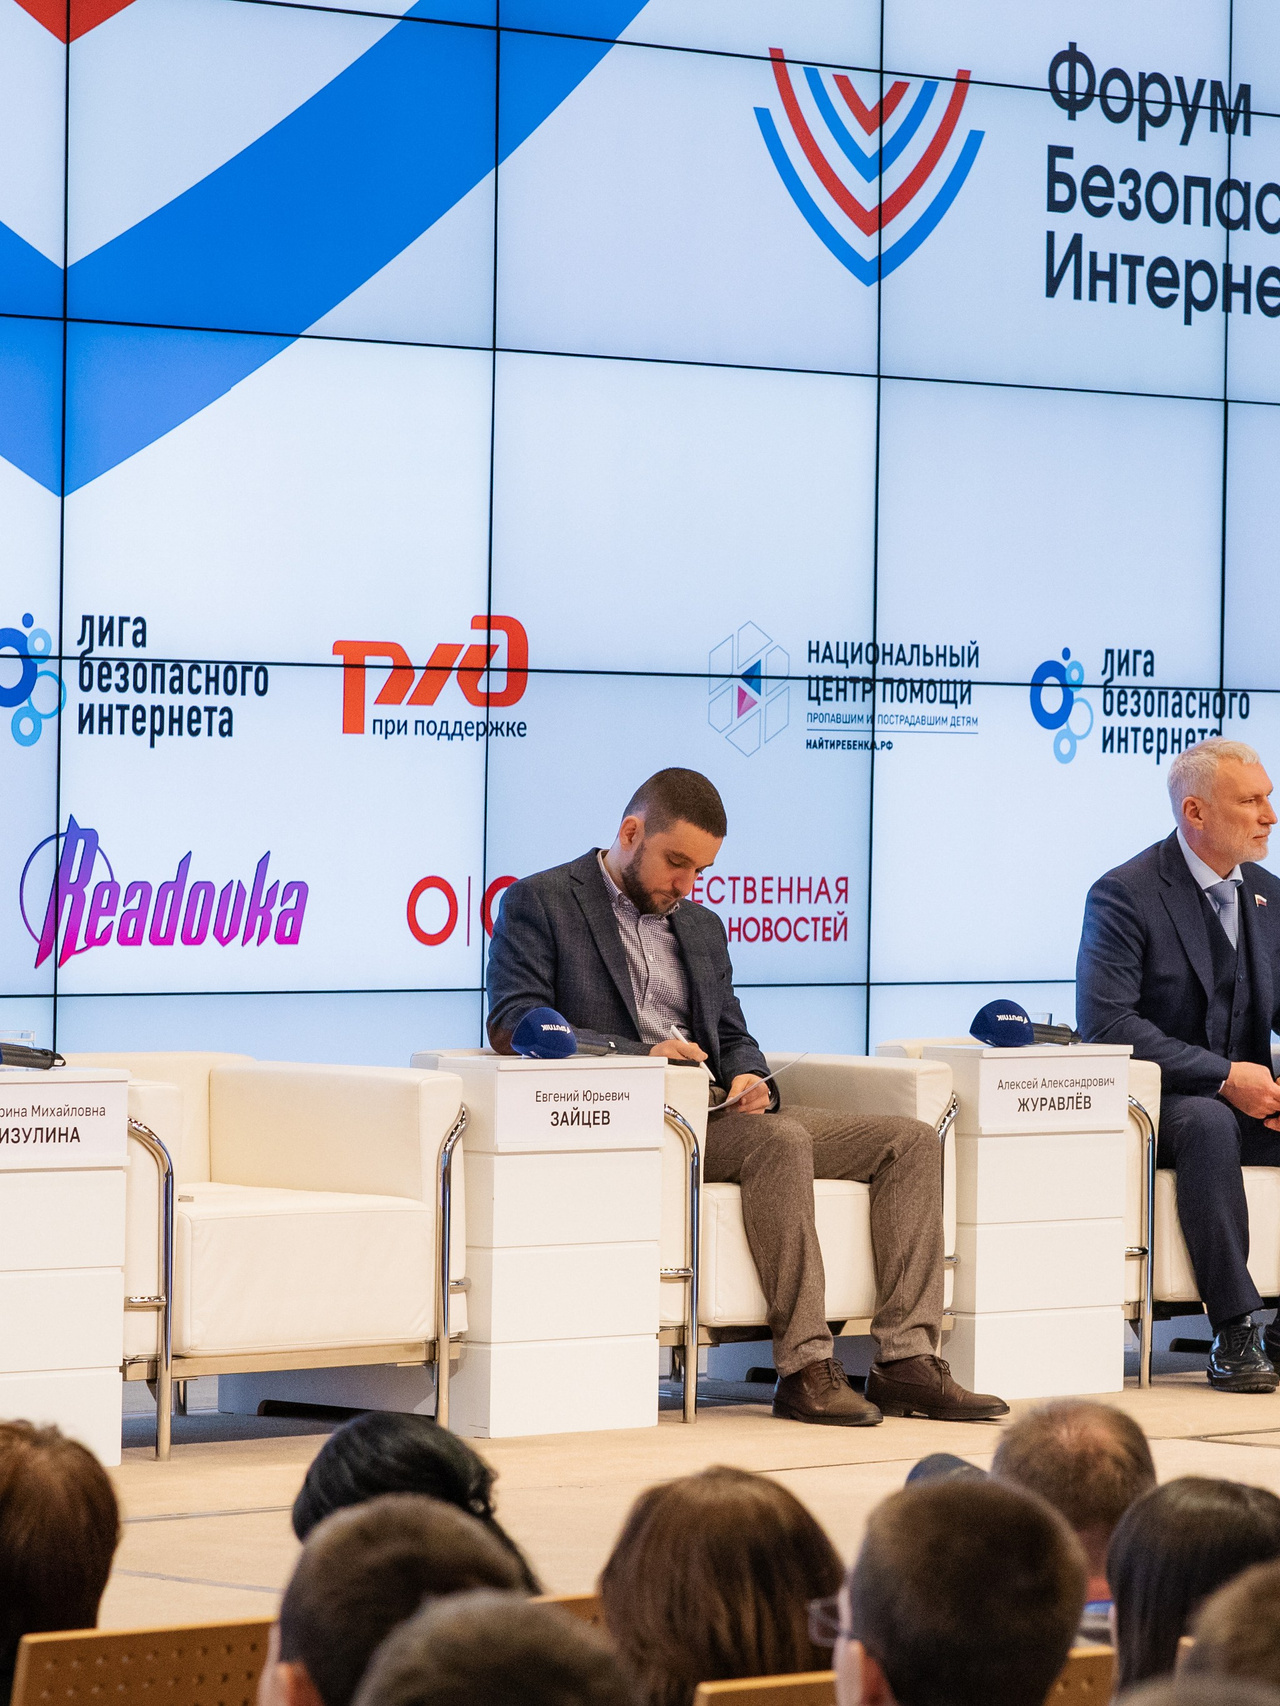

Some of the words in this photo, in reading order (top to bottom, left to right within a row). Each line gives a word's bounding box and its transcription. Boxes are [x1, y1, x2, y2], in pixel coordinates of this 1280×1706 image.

[1048, 42, 1251, 146] Форум
[77, 614, 147, 648] лига
[807, 640, 979, 668] НАЦИОНАЛЬНЫЙ
[1101, 647, 1155, 678] лига
[78, 646, 269, 697] безопасного
[807, 675, 873, 705] ЦЕНТР
[882, 679, 972, 709] ПОМОЩИ
[1102, 677, 1250, 720] безопасного
[77, 703, 234, 748] интернета
[372, 718, 408, 739] при
[414, 719, 528, 741] поддержке
[807, 712, 864, 725] ПРОПАВШИМ
[877, 714, 948, 727] ПОСТРАДАВШИМ
[950, 716, 979, 728] ДЕТЯМ
[806, 739, 893, 751] НАЙТИРЕБЕНКА.РФ
[34, 813, 309, 969] Readovka
[728, 911, 848, 942] НОВОСТЕЙ
[535, 1090, 579, 1102] Евгений
[582, 1090, 630, 1104] Юрьевич
[997, 1078, 1038, 1090] Алексей
[1041, 1077, 1115, 1090] Александрович
[31, 1104, 106, 1117] Михайловна
[1017, 1093, 1092, 1112] ЖУРАВЛЁВ
[550, 1107, 611, 1128] ЗАЙЦЕВ
